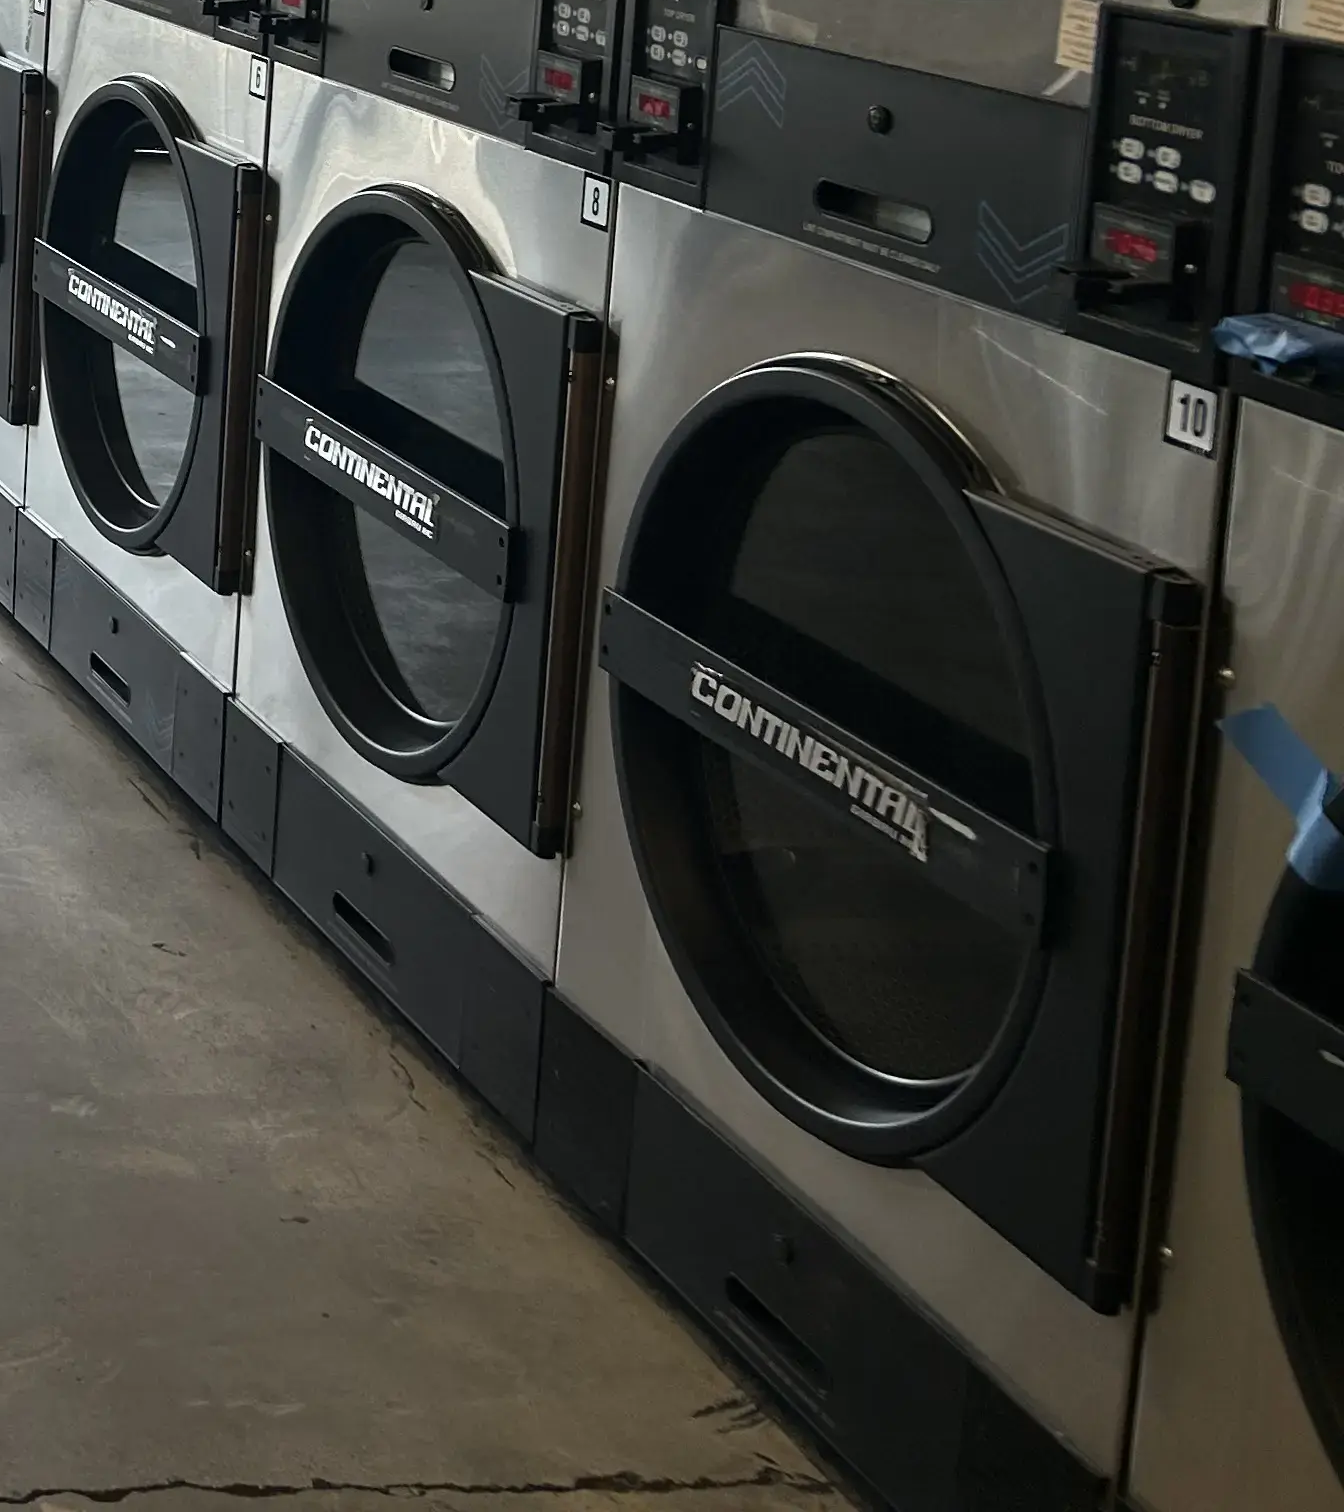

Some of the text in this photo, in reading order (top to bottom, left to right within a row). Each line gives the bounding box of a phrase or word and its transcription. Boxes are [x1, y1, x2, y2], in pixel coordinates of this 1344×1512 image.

[256, 66, 261, 88] 6
[592, 187, 600, 216] 8
[68, 274, 154, 344] CONTINENTAL
[1178, 393, 1208, 438] 10
[305, 425, 434, 527] CONTINENTAL
[691, 671, 927, 842] CONTINENTAL
